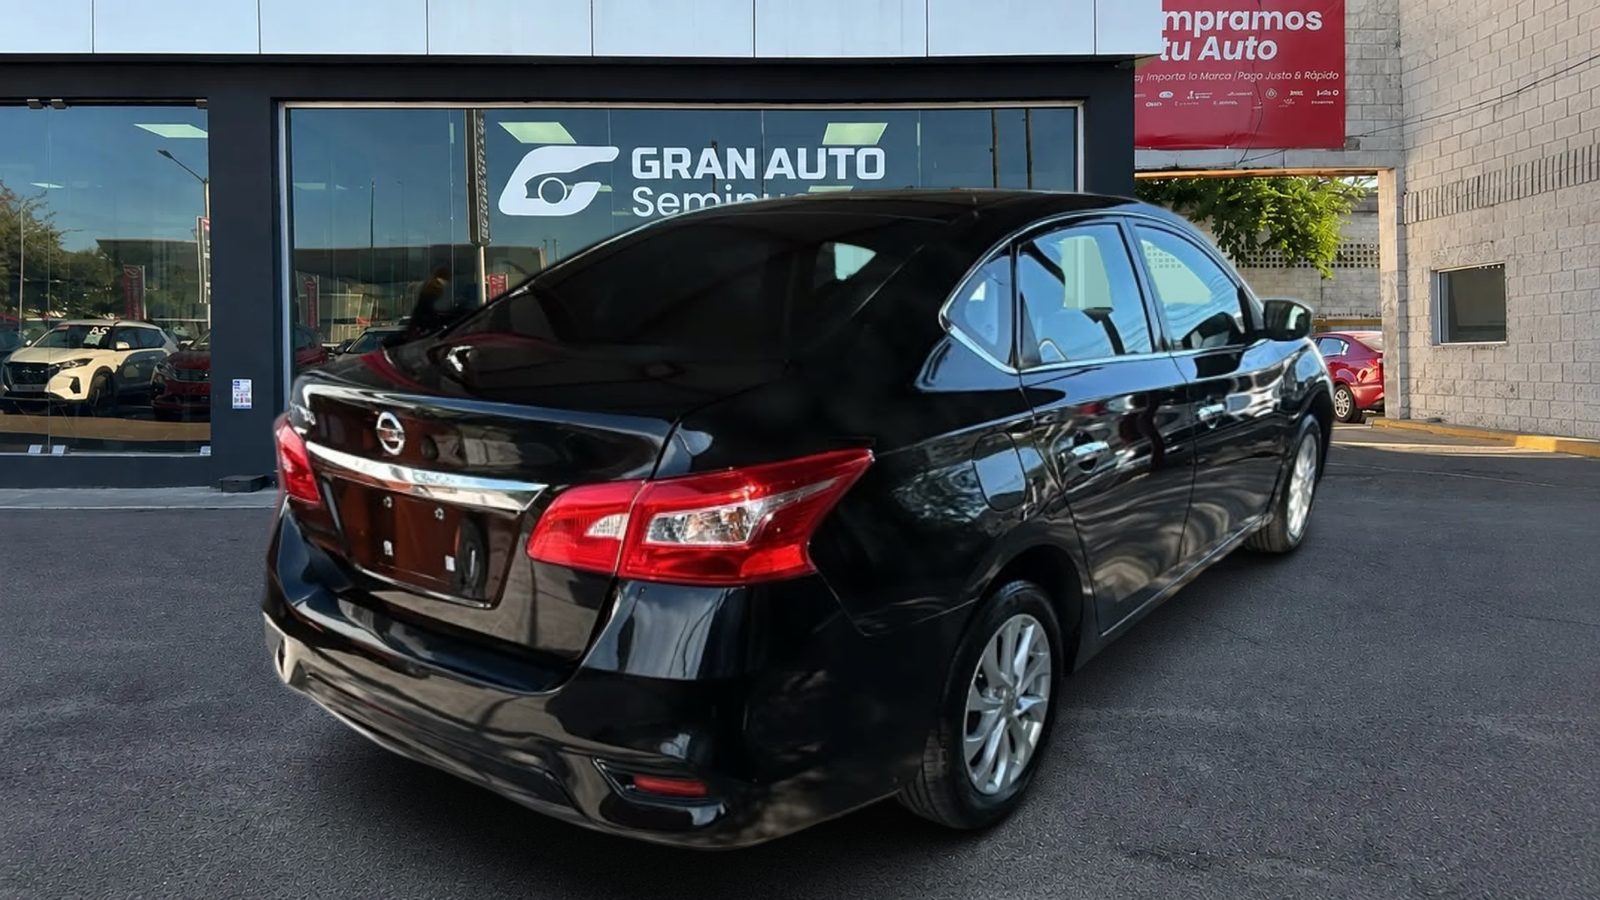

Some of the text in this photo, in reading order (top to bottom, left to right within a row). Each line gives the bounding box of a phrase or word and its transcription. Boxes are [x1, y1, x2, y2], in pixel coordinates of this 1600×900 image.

[1160, 36, 1278, 61] tu Auto
[1189, 71, 1198, 80] la
[1200, 72, 1232, 80] Marca
[631, 147, 886, 180] GRAN AUTO
